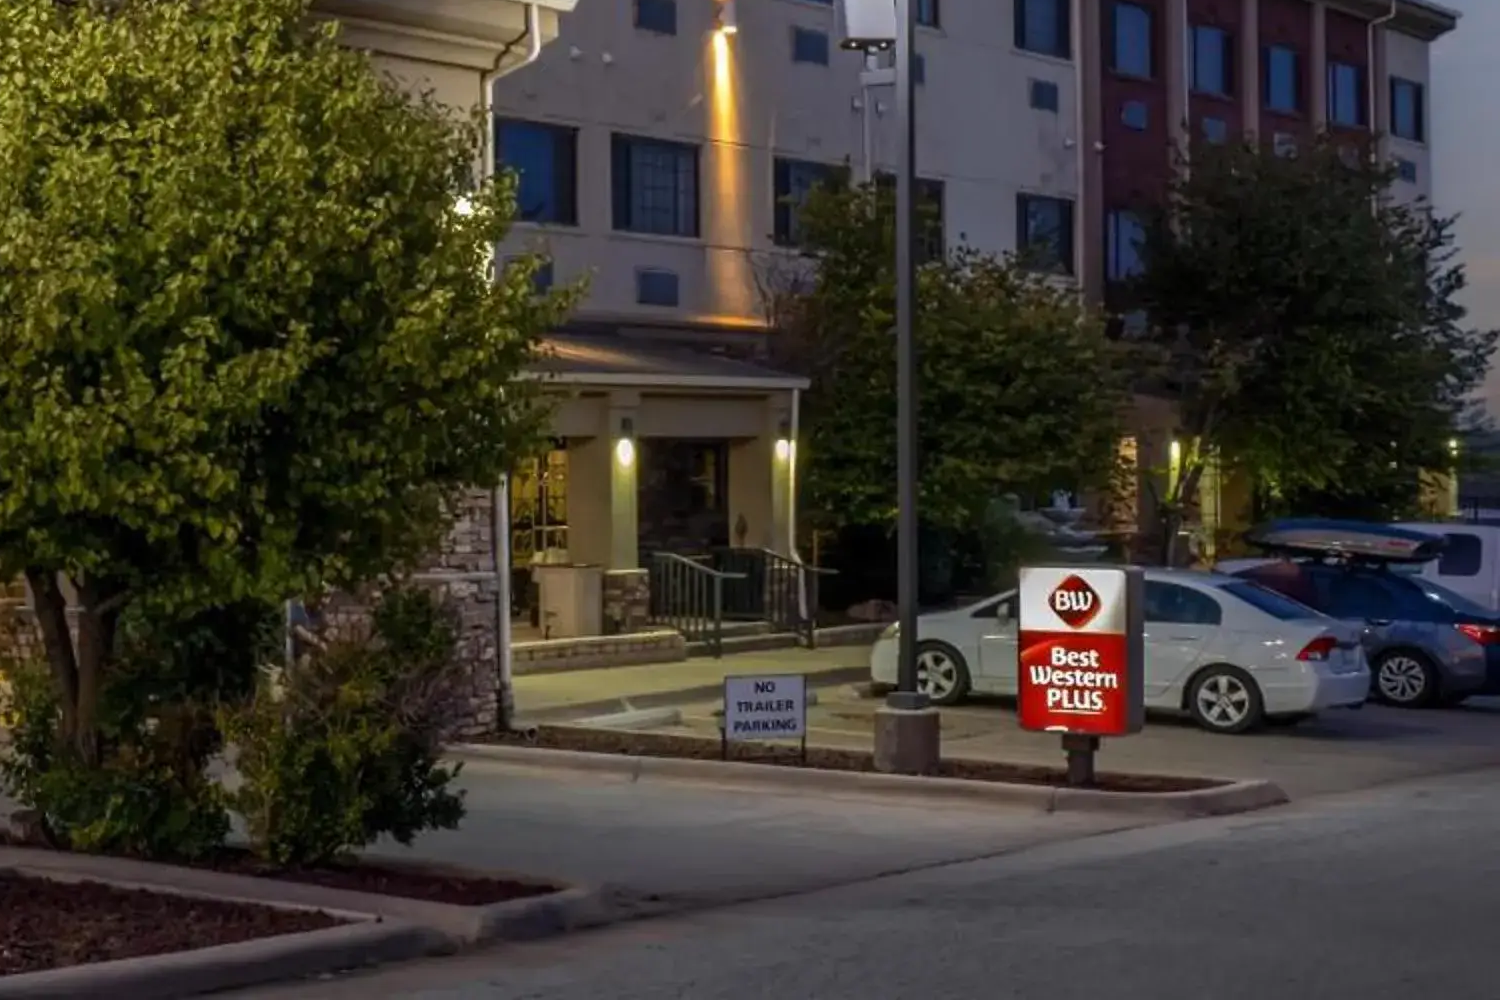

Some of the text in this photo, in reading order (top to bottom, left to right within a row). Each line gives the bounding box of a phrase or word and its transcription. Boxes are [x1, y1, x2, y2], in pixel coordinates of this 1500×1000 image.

[1055, 590, 1092, 611] BW
[1051, 646, 1100, 668] Best
[1029, 666, 1118, 689] Western
[754, 681, 776, 694] NO
[736, 699, 795, 713] TRAILER
[733, 718, 797, 733] PARKING
